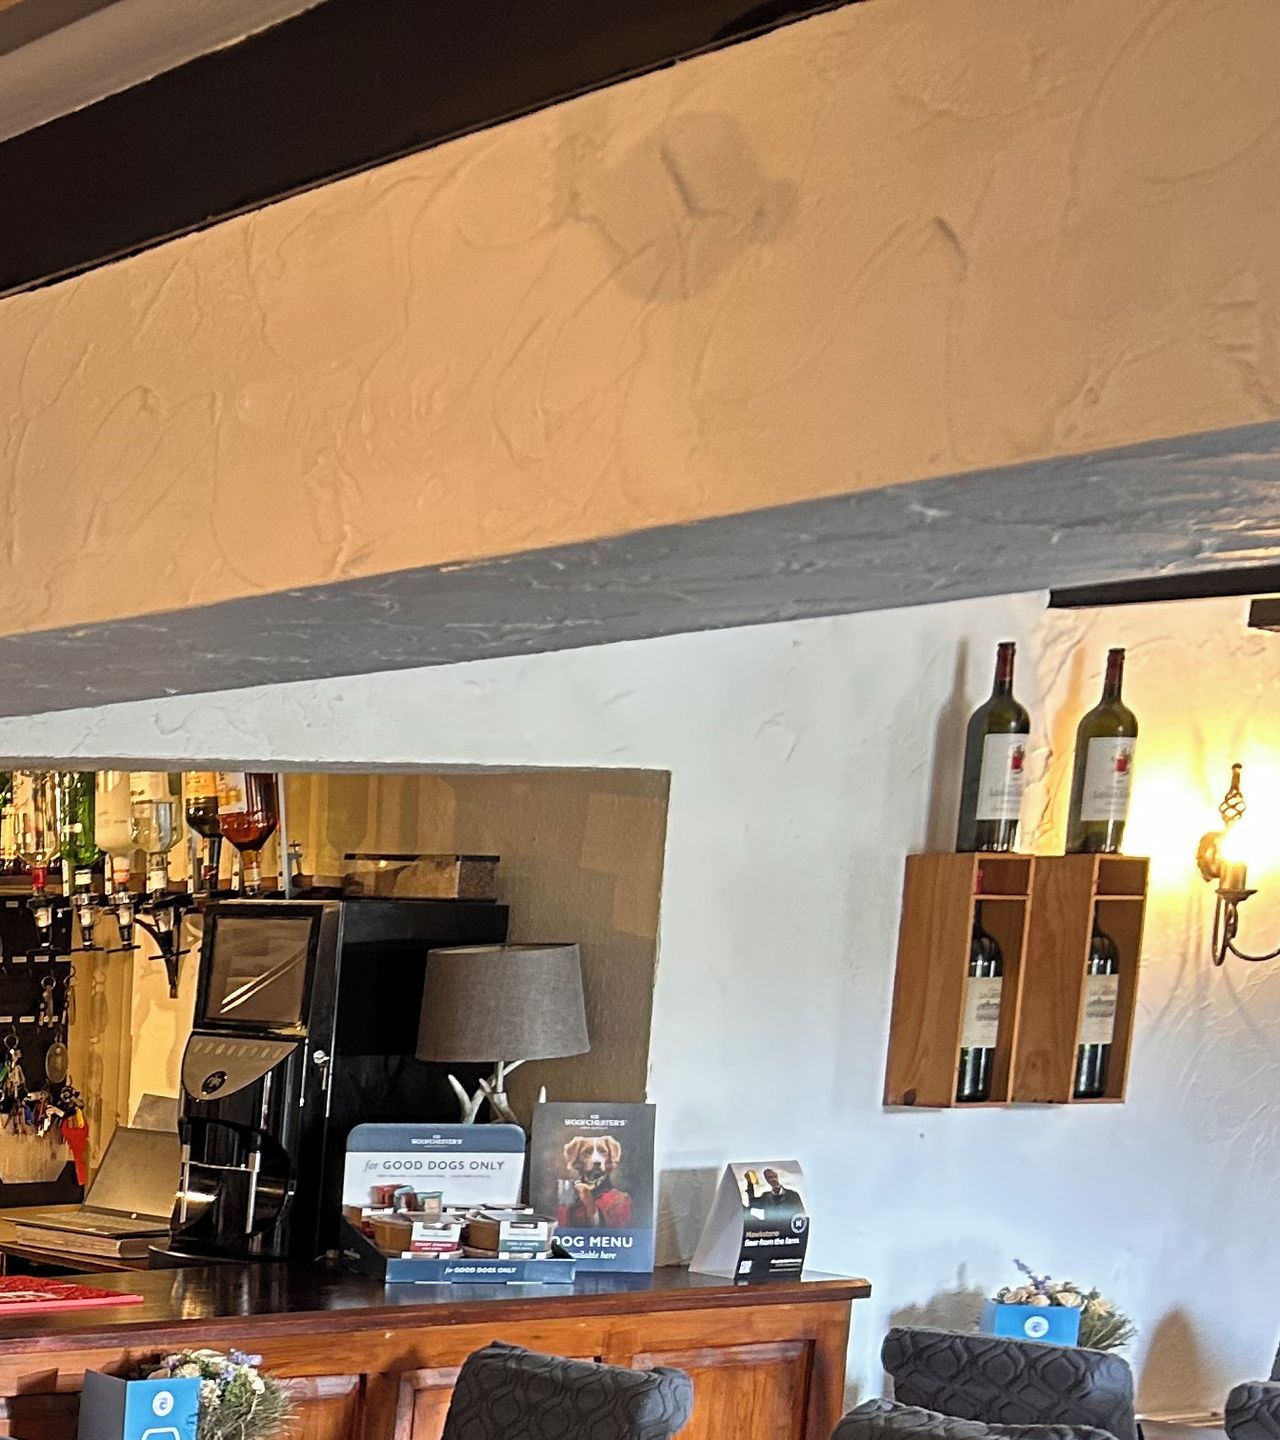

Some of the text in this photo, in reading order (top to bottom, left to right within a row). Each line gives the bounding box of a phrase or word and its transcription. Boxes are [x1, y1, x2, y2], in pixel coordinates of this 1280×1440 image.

[363, 1159, 506, 1173] for GOOD DOGS ONLY
[589, 1235, 634, 1248] MENU
[453, 1266, 476, 1274] GOOD
[497, 1266, 518, 1274] ONLY
